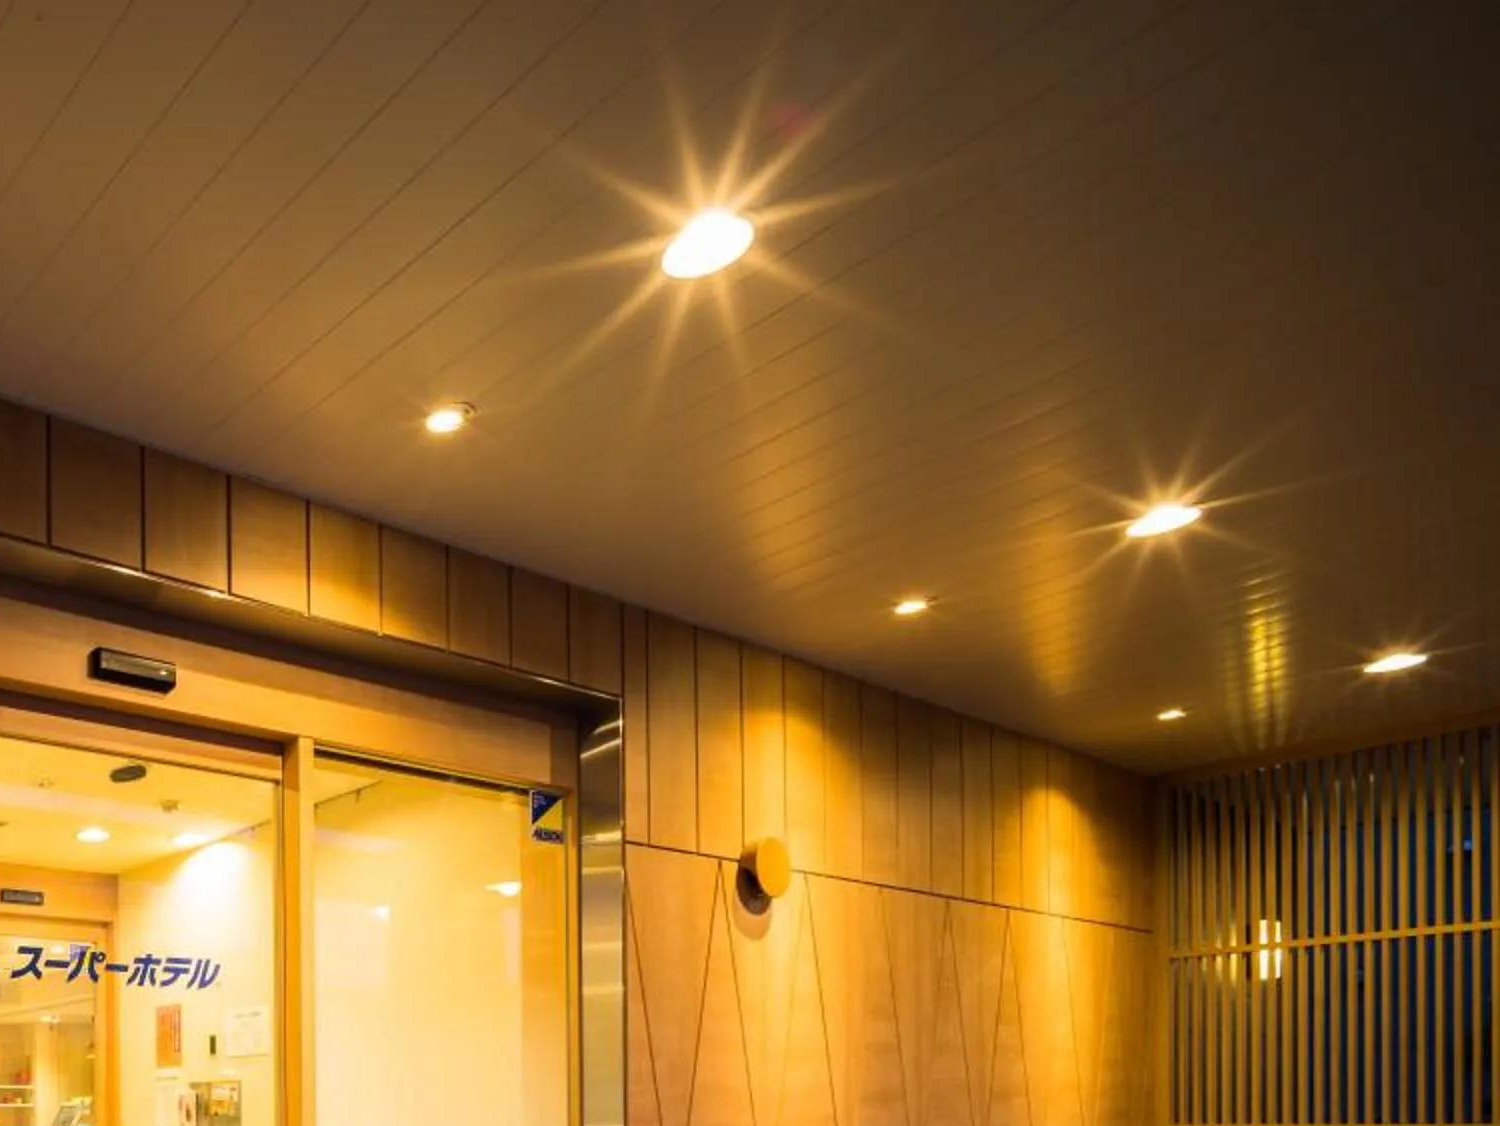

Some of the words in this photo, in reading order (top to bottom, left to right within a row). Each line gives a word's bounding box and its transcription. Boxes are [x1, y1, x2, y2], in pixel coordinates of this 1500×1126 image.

[10, 944, 220, 989] スーパーホテル
